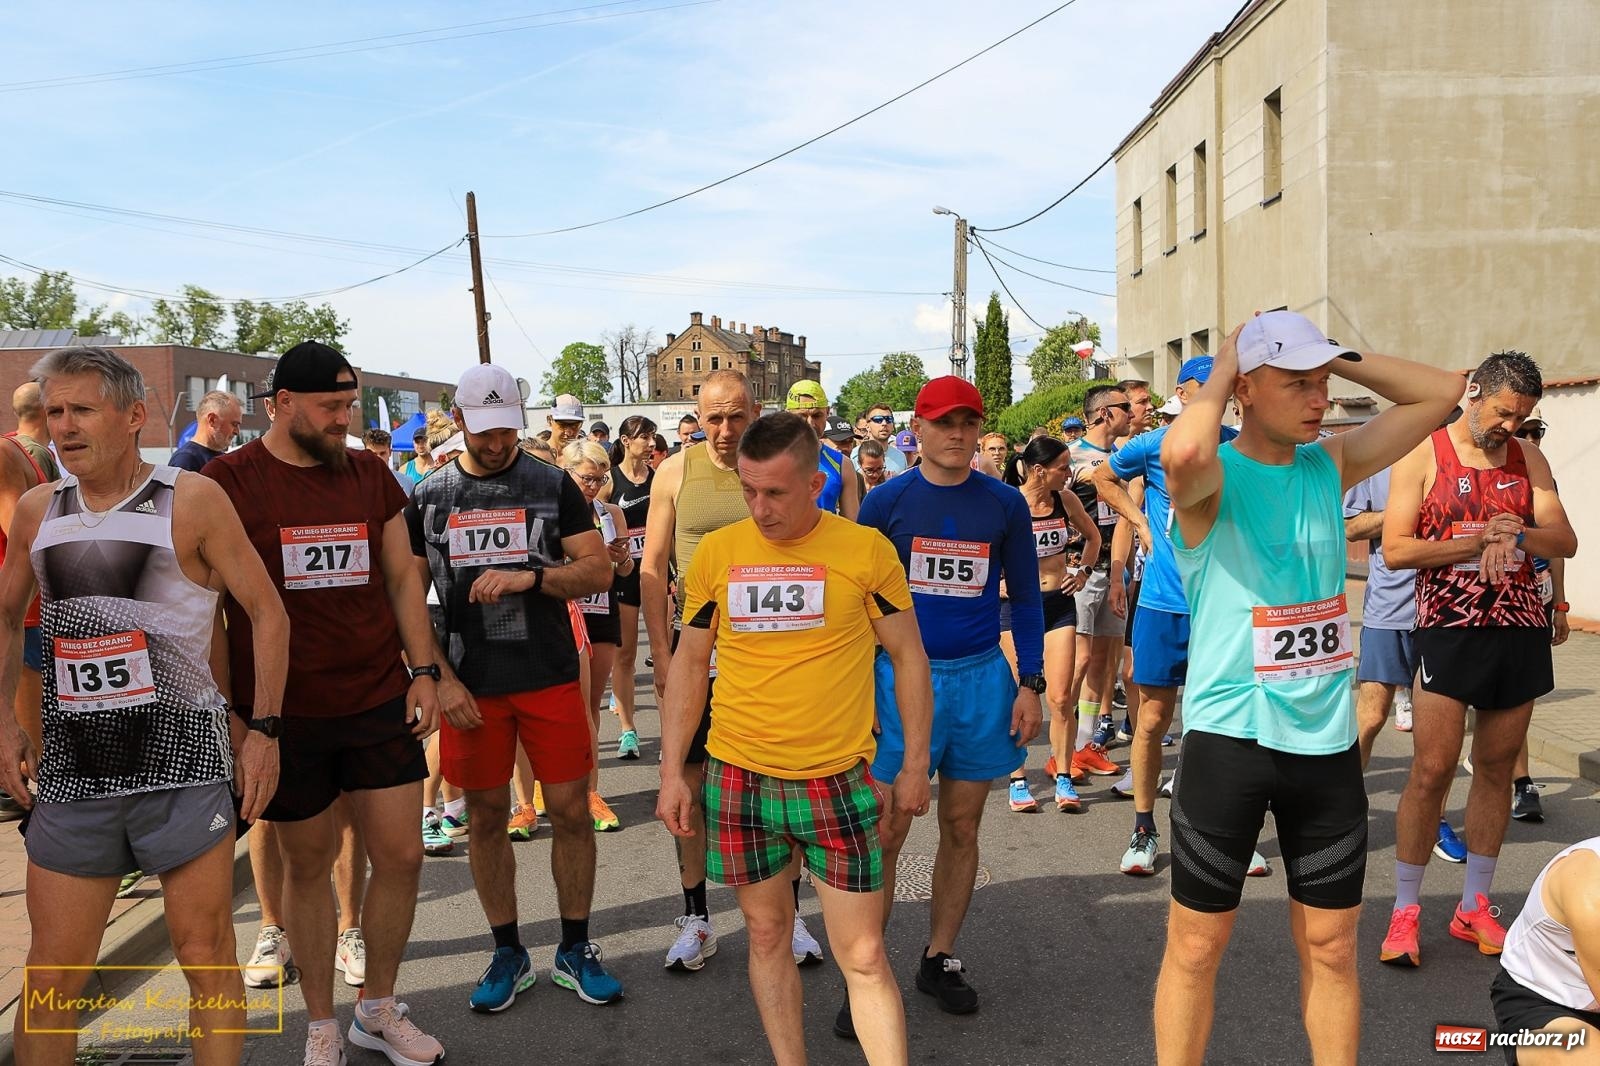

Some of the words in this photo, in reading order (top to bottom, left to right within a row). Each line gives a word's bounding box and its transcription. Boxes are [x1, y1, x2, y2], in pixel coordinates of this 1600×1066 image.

[465, 526, 510, 551] 170
[304, 544, 351, 571] 217
[926, 557, 974, 582] 155
[747, 584, 805, 613] 143
[1266, 609, 1281, 617] XVI
[1282, 607, 1301, 615] BIEG
[1301, 604, 1316, 613] BEZ
[1316, 599, 1340, 611] GRANIC
[82, 641, 99, 649] BEZ
[99, 635, 133, 647] GRANIC
[1274, 622, 1340, 661] 238
[67, 658, 131, 693] 135
[208, 820, 229, 832] adidas
